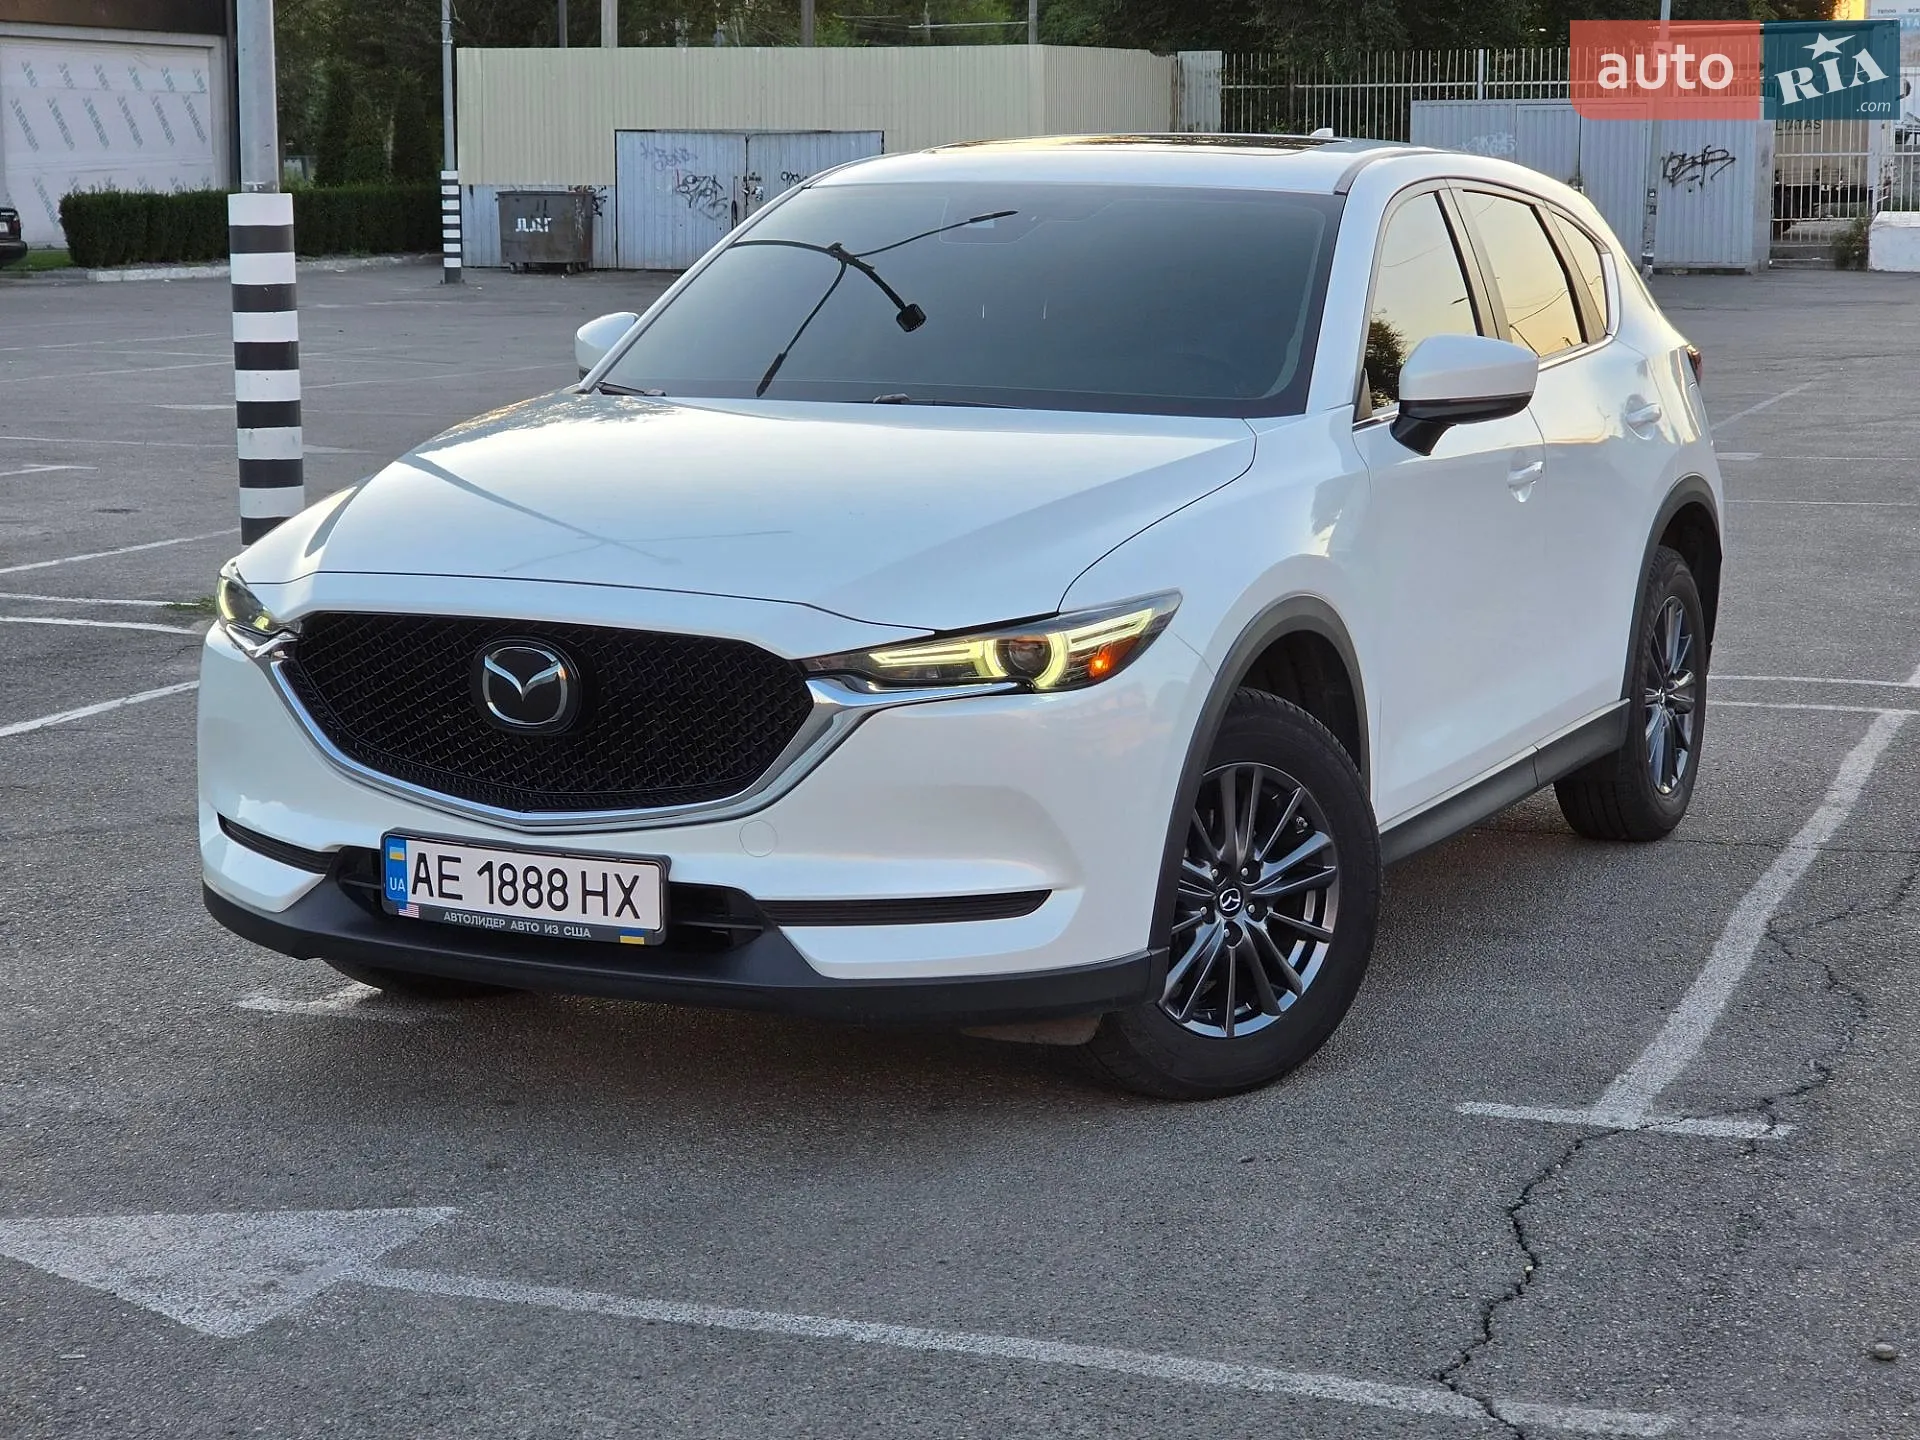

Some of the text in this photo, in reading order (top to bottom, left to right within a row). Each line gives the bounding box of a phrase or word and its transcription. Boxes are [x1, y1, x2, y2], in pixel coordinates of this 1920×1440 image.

[390, 876, 406, 892] UA
[411, 852, 641, 920] AE 1888 HX
[443, 911, 592, 938] АВТОЛИДЕР АВТО ИЗ США
